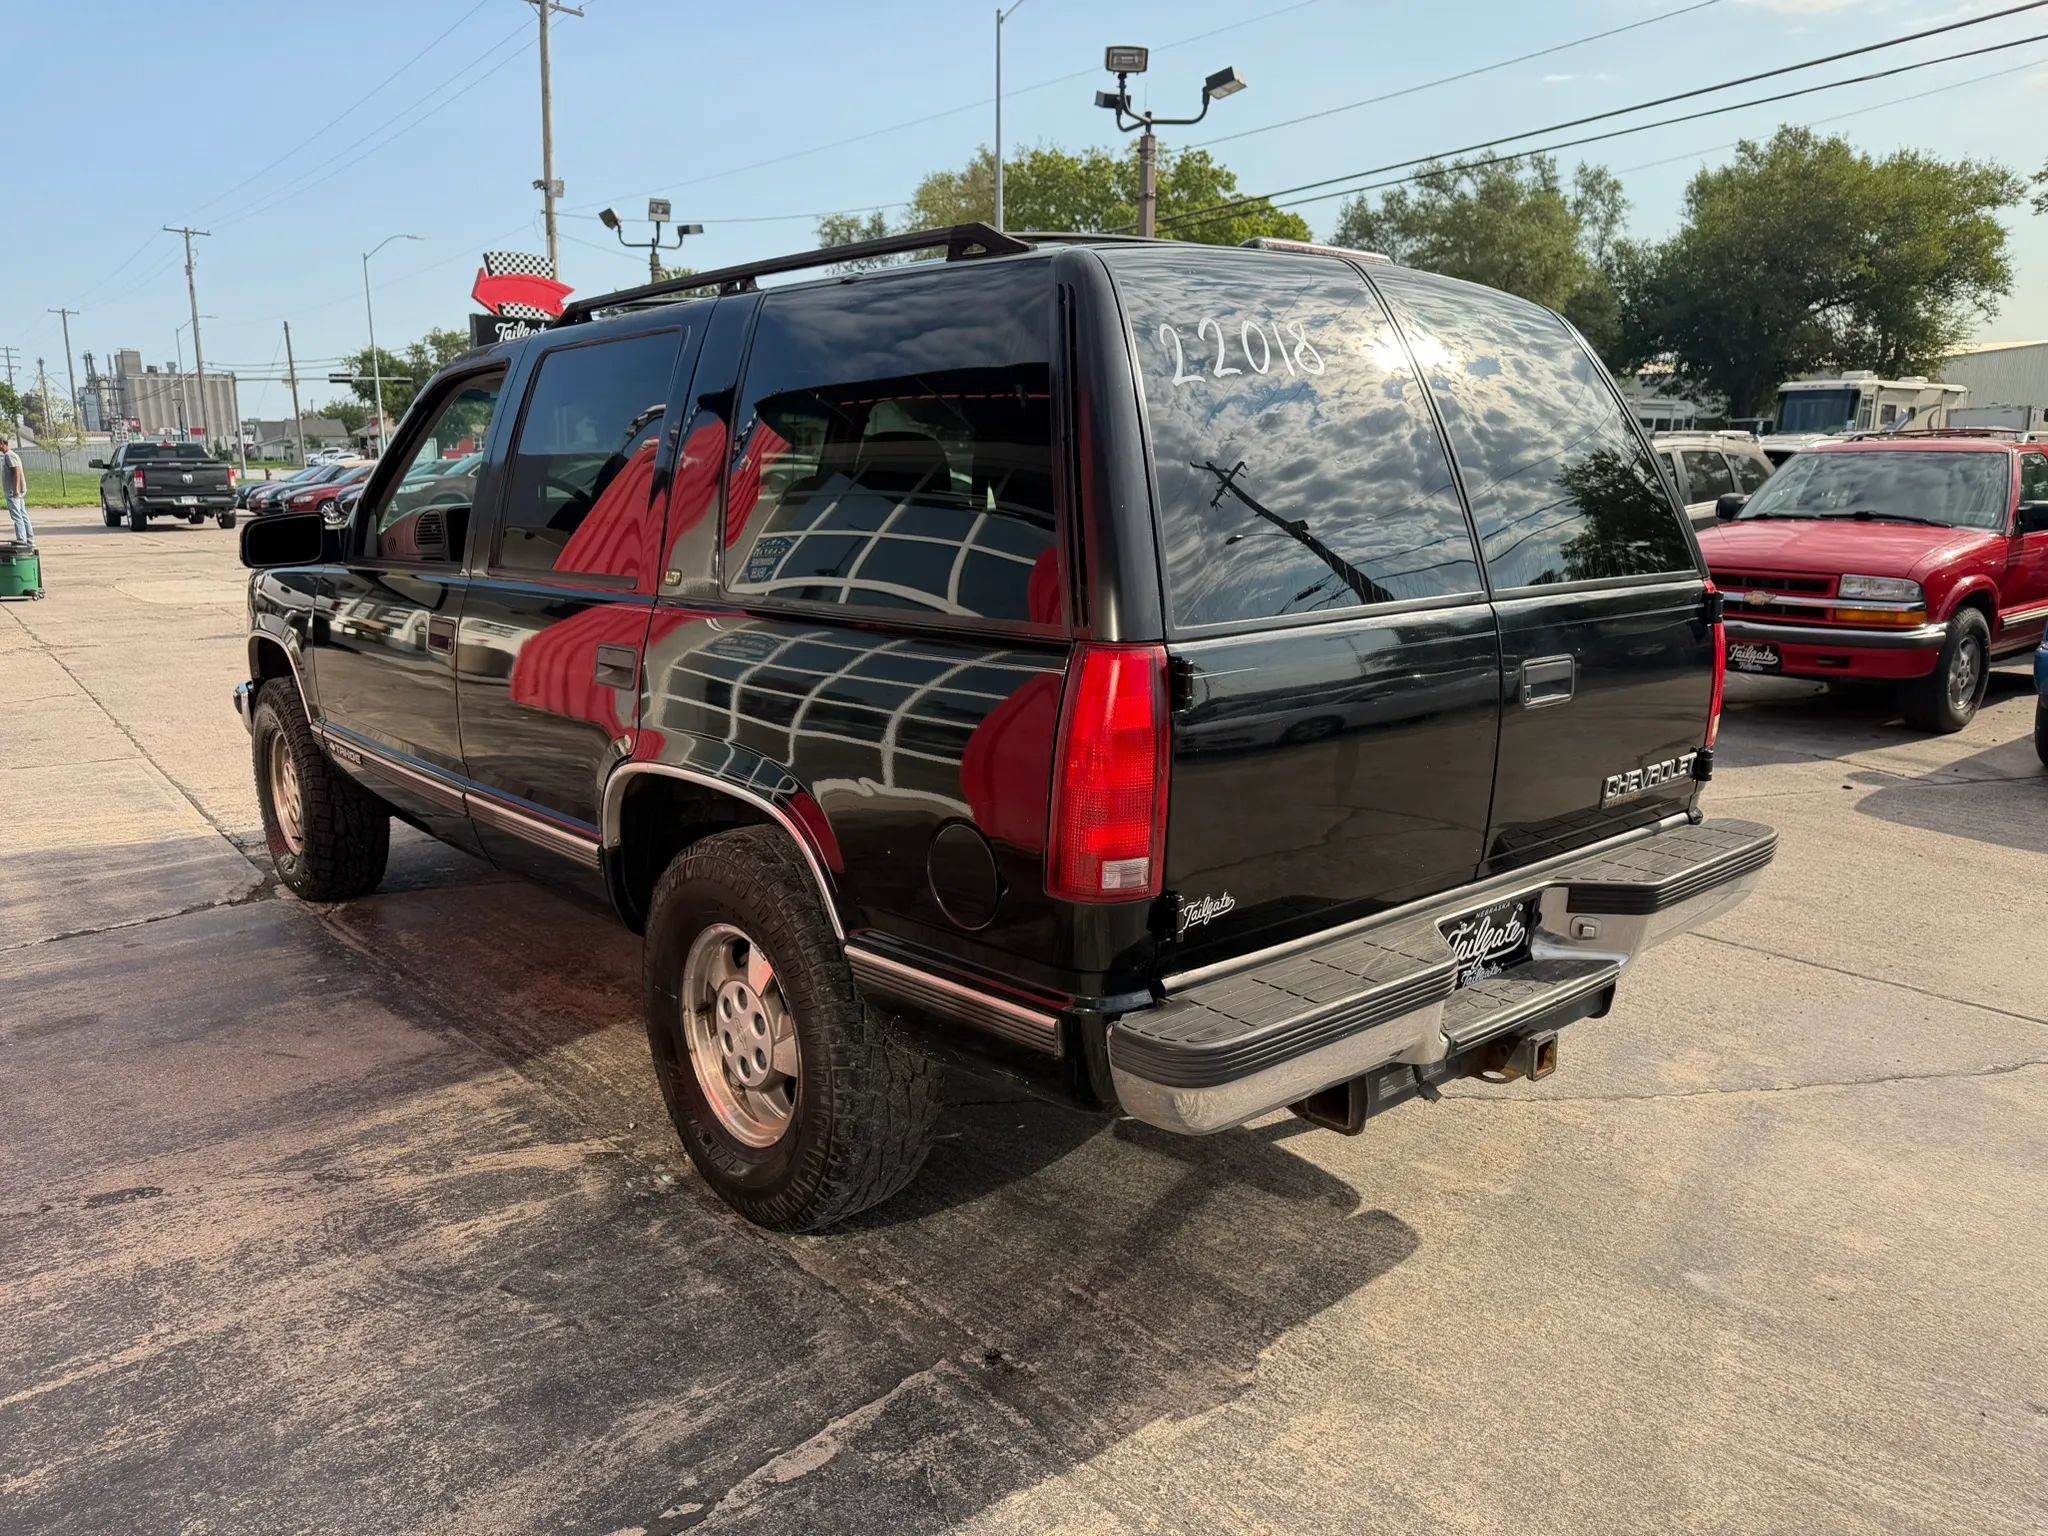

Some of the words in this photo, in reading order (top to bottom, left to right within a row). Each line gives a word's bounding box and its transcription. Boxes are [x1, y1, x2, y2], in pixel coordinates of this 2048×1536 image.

[1159, 317, 1325, 387] 22018
[665, 571, 680, 583] LT
[1728, 644, 1779, 665] Tailgate
[335, 744, 361, 765] TAHOE
[1605, 752, 1698, 799] CHEVROLET
[1183, 892, 1236, 930] Tailgate
[1475, 901, 1511, 919] NEBRASKA
[1447, 910, 1525, 970] Tailgate
